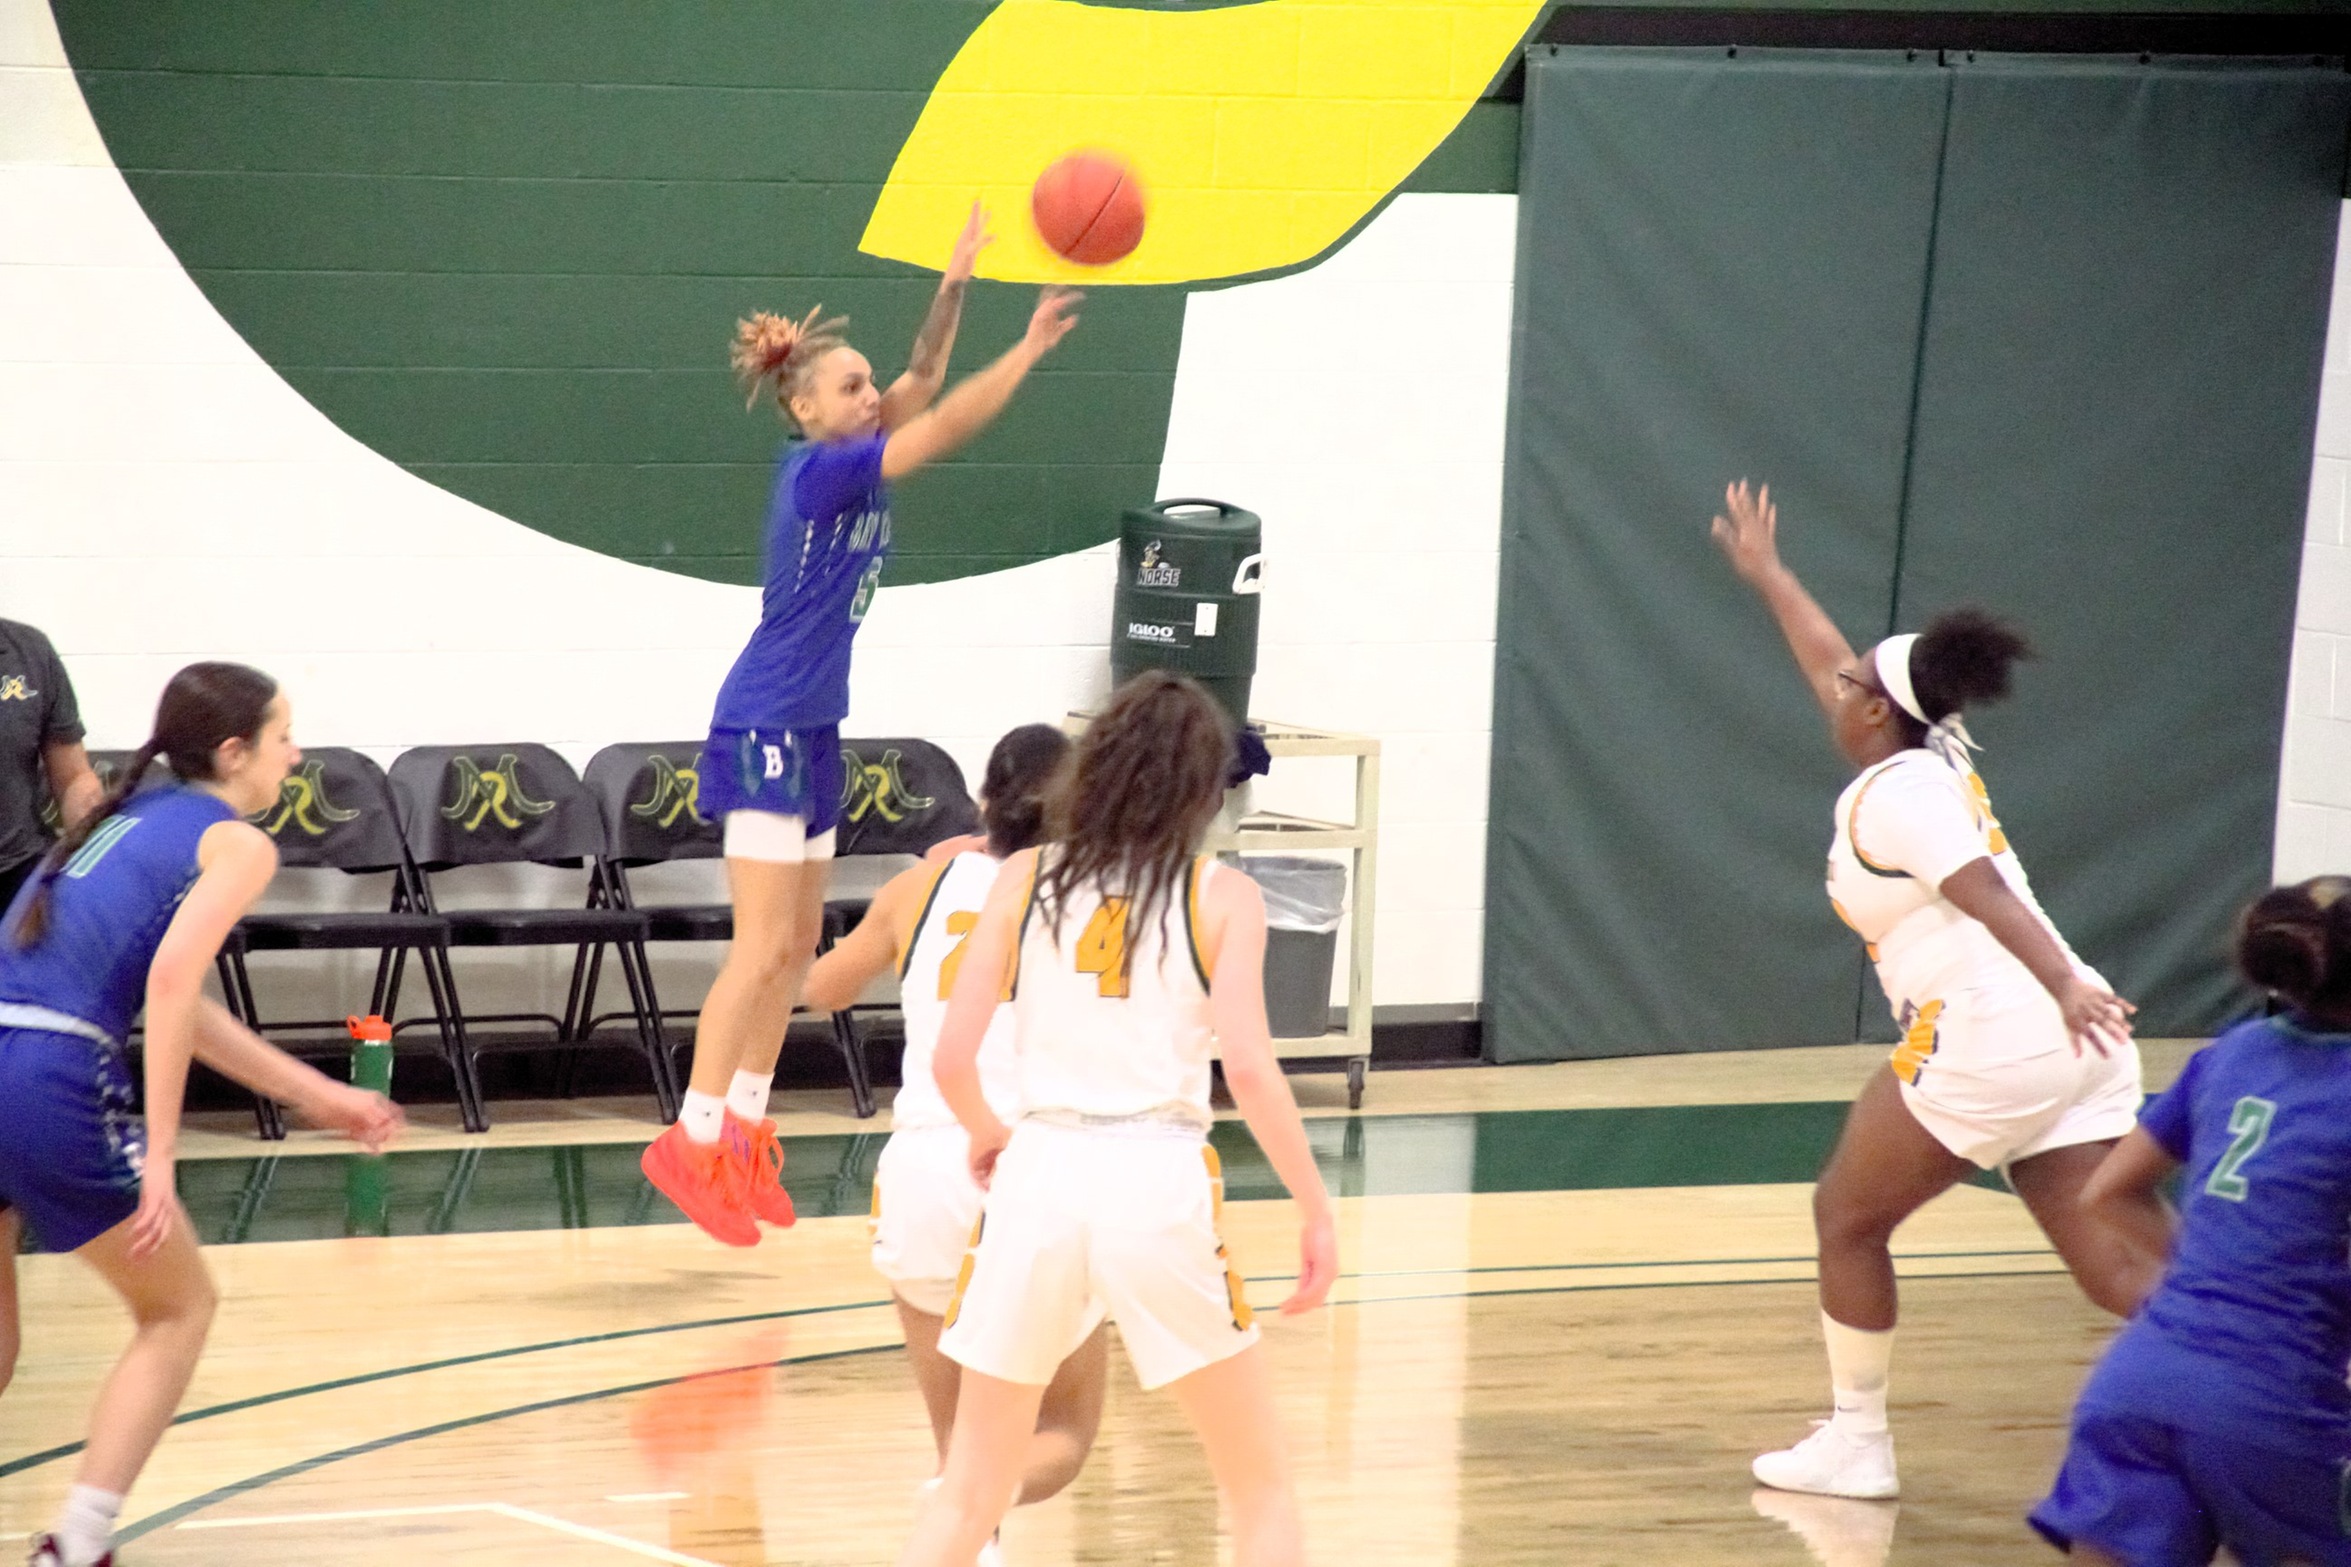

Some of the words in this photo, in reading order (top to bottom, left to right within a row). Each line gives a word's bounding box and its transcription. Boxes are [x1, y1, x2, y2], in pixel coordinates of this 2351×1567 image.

[1138, 567, 1181, 588] NORSE
[1128, 622, 1174, 638] IGLOO
[762, 744, 784, 780] B
[1076, 895, 1132, 999] 4
[2204, 1095, 2278, 1203] 2
